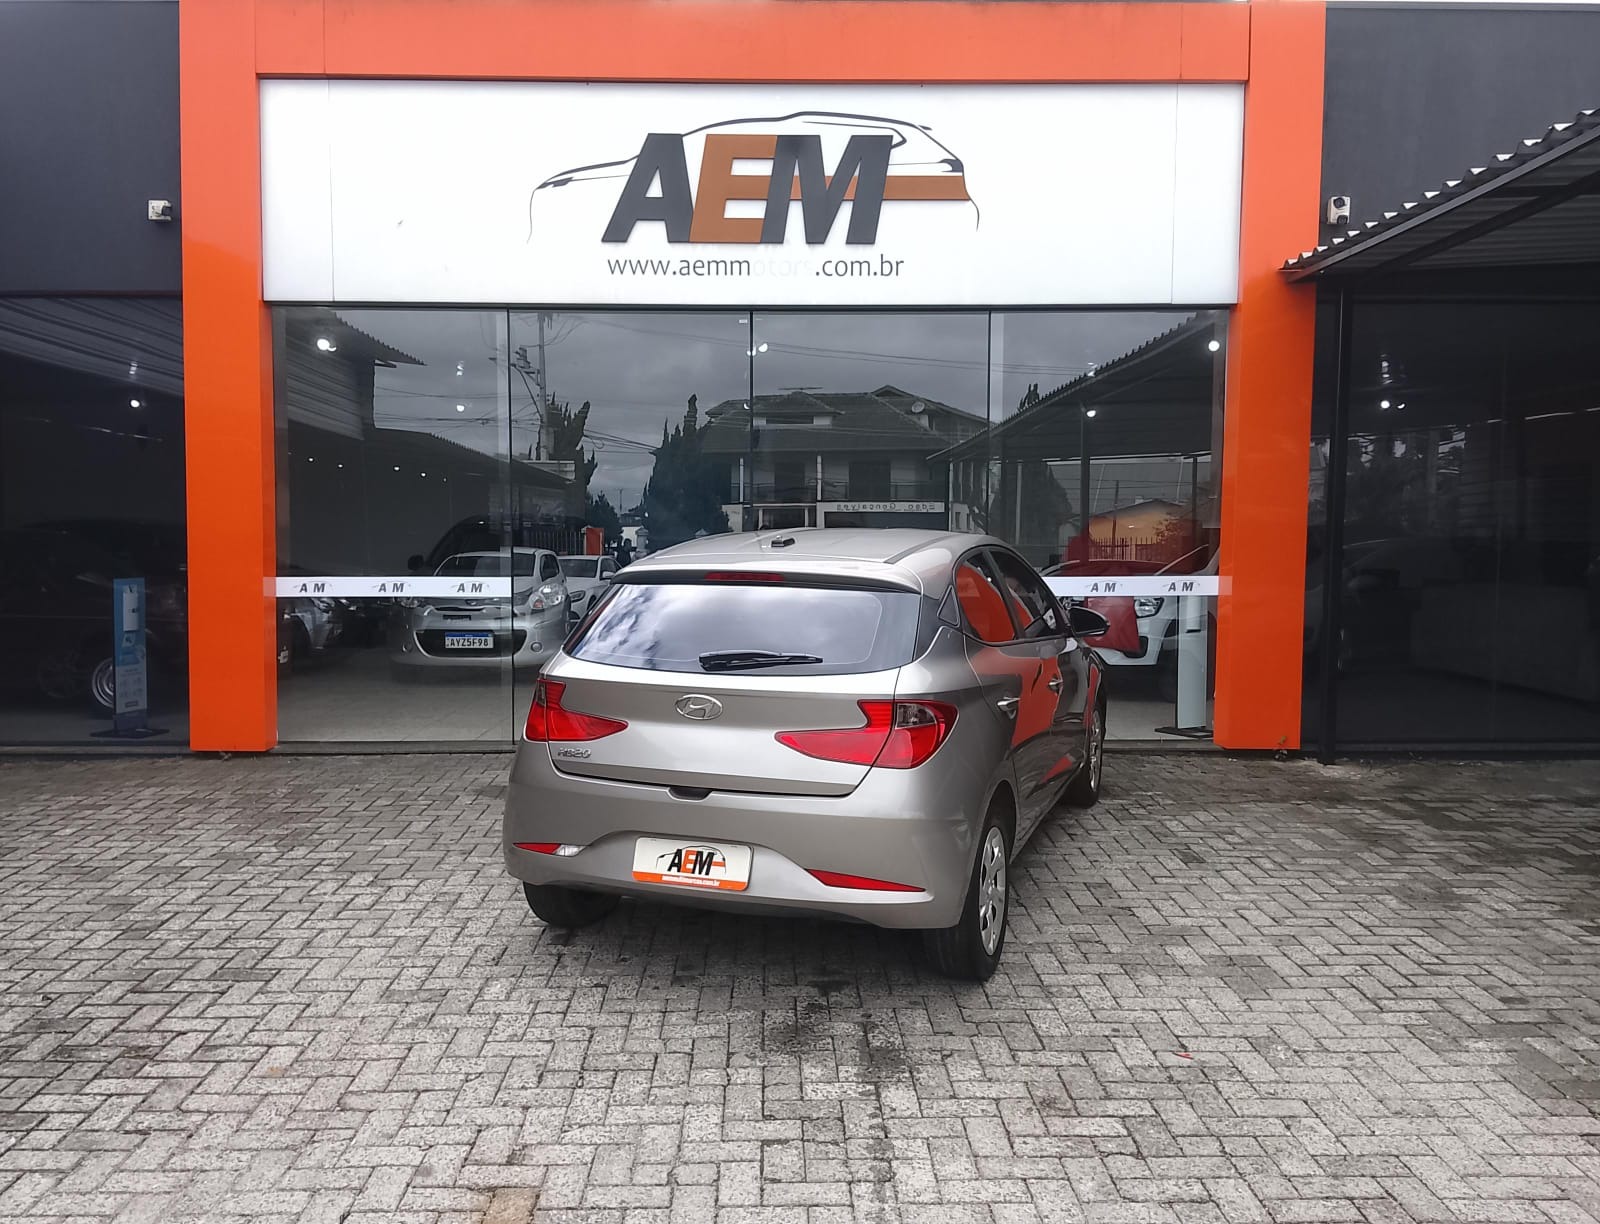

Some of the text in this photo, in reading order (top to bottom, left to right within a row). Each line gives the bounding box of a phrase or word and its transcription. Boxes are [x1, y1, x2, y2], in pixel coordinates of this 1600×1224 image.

[601, 133, 893, 244] AEM
[450, 638, 489, 647] AYZ5F98
[557, 747, 592, 759] HB20
[667, 848, 715, 876] AEM
